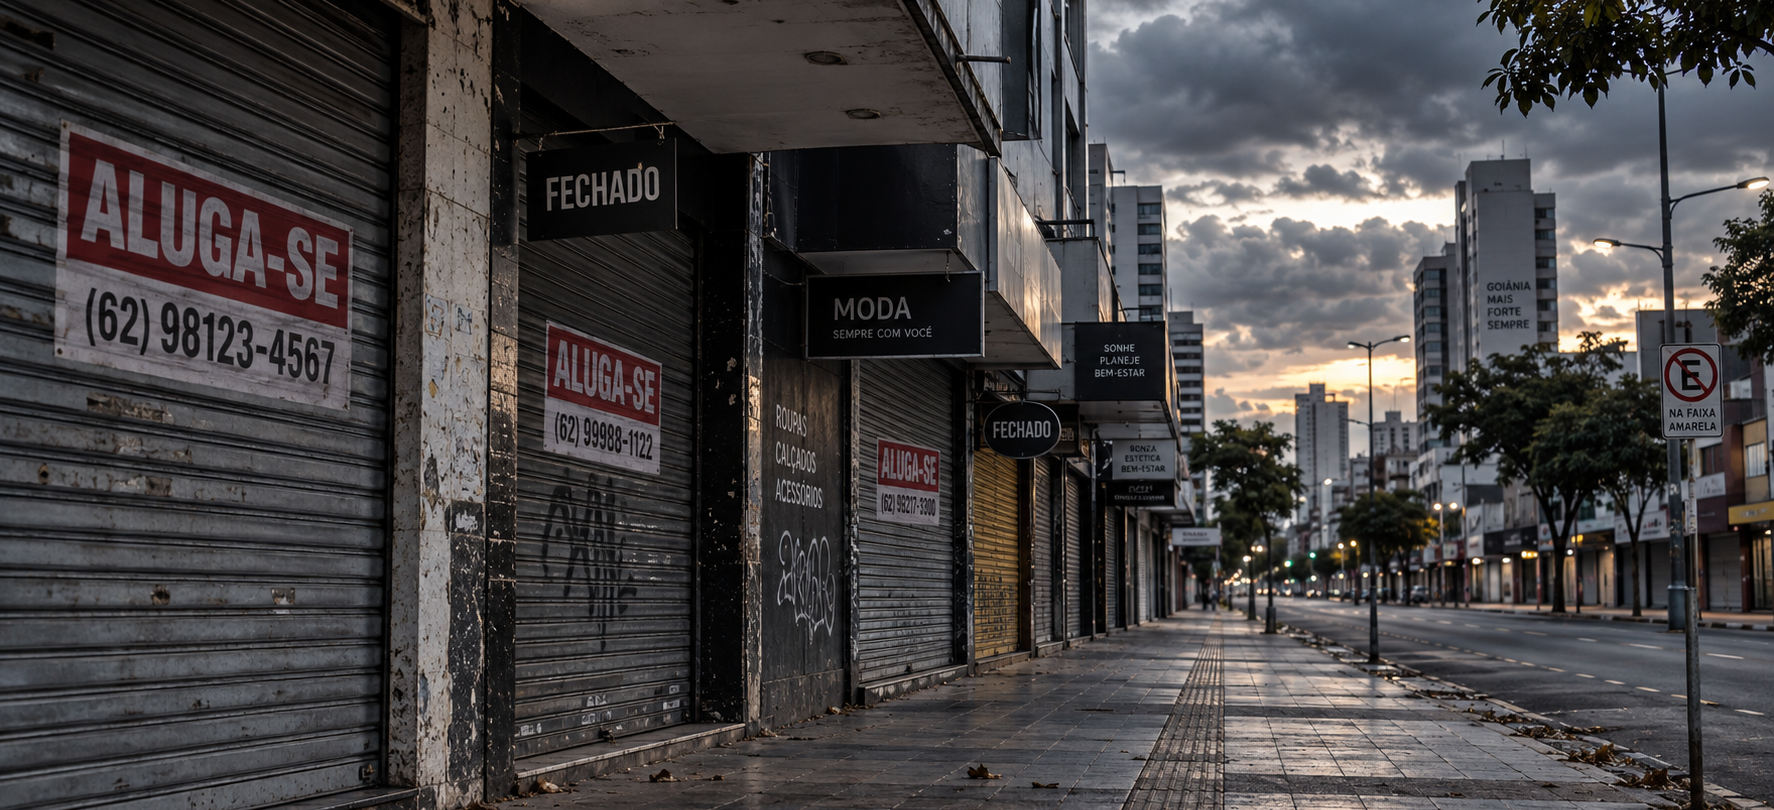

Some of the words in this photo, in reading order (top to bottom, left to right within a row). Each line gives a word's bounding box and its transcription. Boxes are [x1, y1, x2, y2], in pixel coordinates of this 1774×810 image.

[546, 165, 660, 212] FECHADO
[80, 158, 339, 309] ALUGA-SE
[1487, 279, 1531, 292] GOIÂNIA
[834, 296, 912, 321] MODA
[1487, 294, 1514, 304] MAIS
[1487, 307, 1522, 317] FORTE
[833, 328, 874, 339] SEMPRE
[877, 328, 901, 339] COM
[1487, 319, 1531, 330] SEMPRE
[86, 288, 150, 356] (62)
[160, 302, 335, 385] 98123-4567
[1104, 344, 1135, 353] SONHE
[1100, 356, 1140, 365] PLANEJE
[553, 339, 655, 415] ALUGA-SE
[1094, 368, 1145, 378] BEM-ESTAR
[1681, 359, 1701, 391] E
[775, 403, 807, 438] ROUPAS
[1669, 408, 1684, 419] NA
[1687, 408, 1717, 419] FAIXA
[554, 411, 580, 448] (62)
[583, 417, 653, 461] 99988-1122
[992, 420, 1052, 440] FECHADO
[1669, 421, 1717, 432] AMARELA
[775, 441, 817, 475] CALÇADOS
[880, 447, 937, 486] ALUGA-SE
[774, 479, 823, 510] ACESSÓRIOS
[881, 493, 895, 515] (62)
